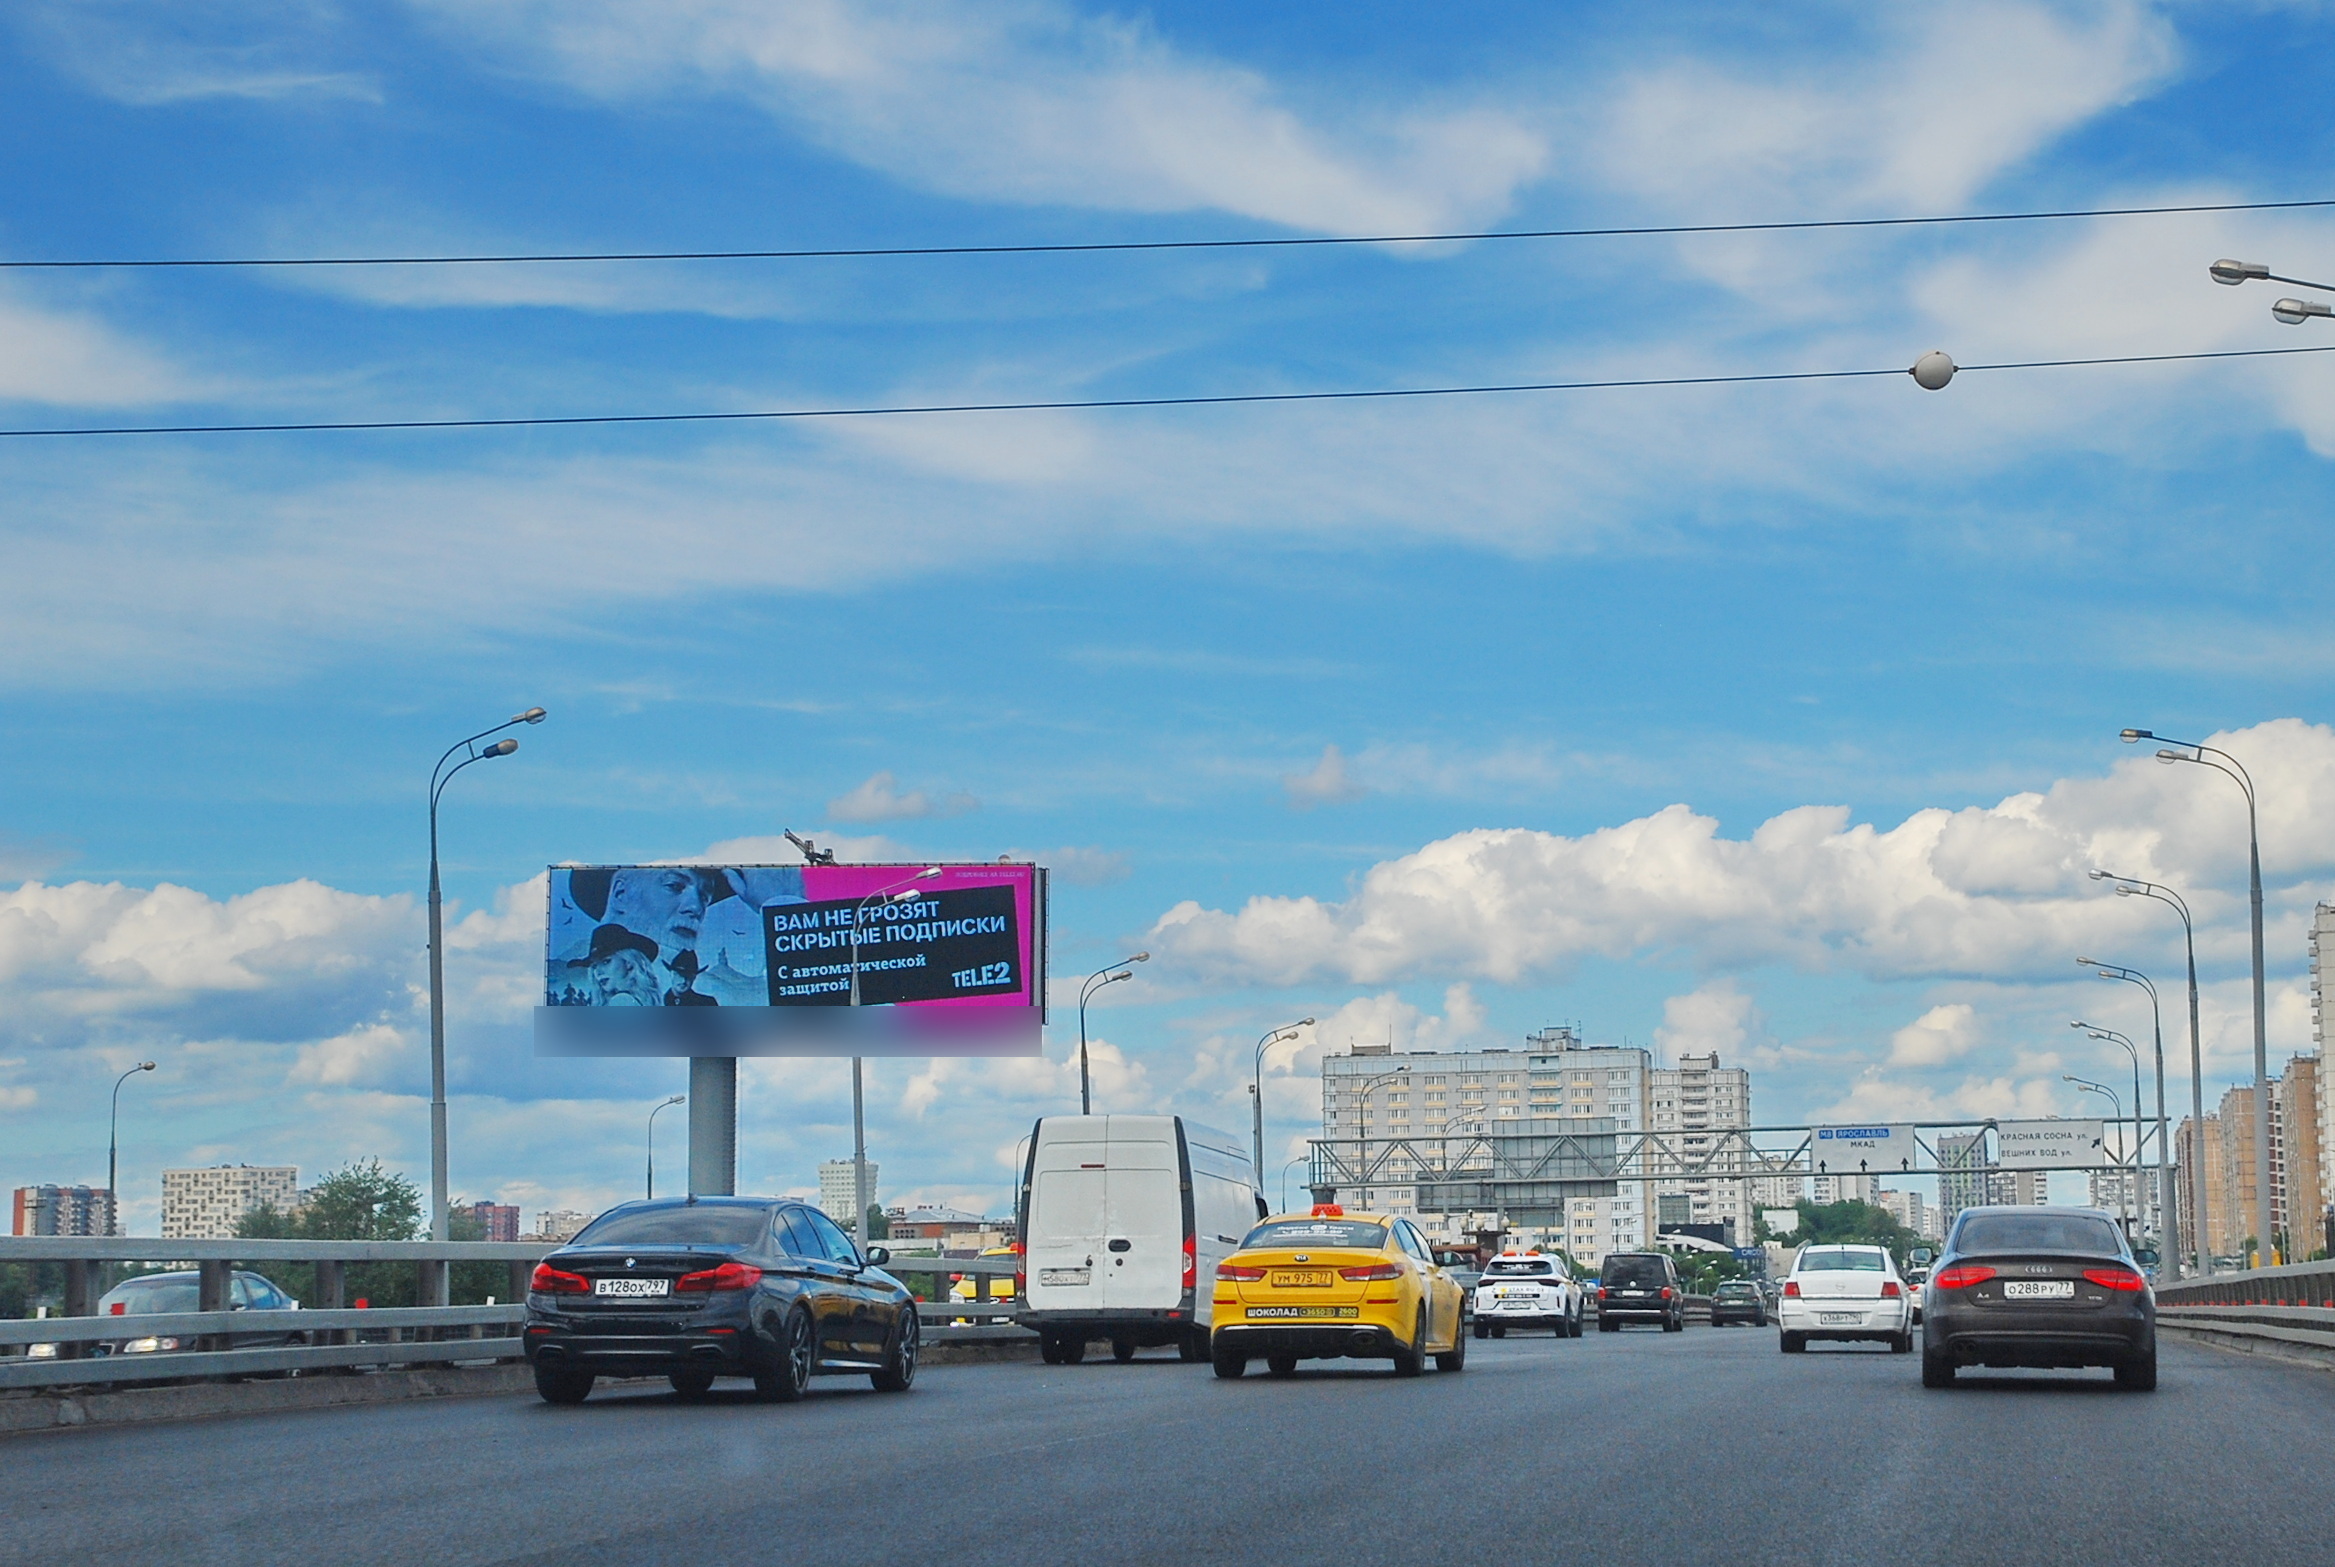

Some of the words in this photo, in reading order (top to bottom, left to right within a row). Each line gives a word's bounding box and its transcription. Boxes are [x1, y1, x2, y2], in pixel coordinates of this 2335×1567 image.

[774, 911, 819, 932] ВАМ
[824, 908, 853, 927] НЕ
[858, 900, 940, 923] ГРОЗЯТ
[775, 926, 882, 952] СКРЫТЫЕ
[885, 915, 1006, 943] ПОДПИСКИ
[777, 965, 789, 980] С
[792, 953, 927, 978] автоматической
[951, 961, 1012, 988] TELE2
[779, 977, 850, 996] защитой
[1837, 1129, 1888, 1139] ЯРОСЛАВЛЬ
[2000, 1132, 2041, 1141] КРАСНАЯ
[2044, 1131, 2073, 1140] СОСНА
[1850, 1140, 1876, 1148] МКАД
[2001, 1149, 2037, 1158] ВЕШНИХ
[1277, 1274, 1290, 1283] УМ
[1294, 1273, 1313, 1283] 975
[1247, 1308, 1299, 1317] ШОКОЛАД
